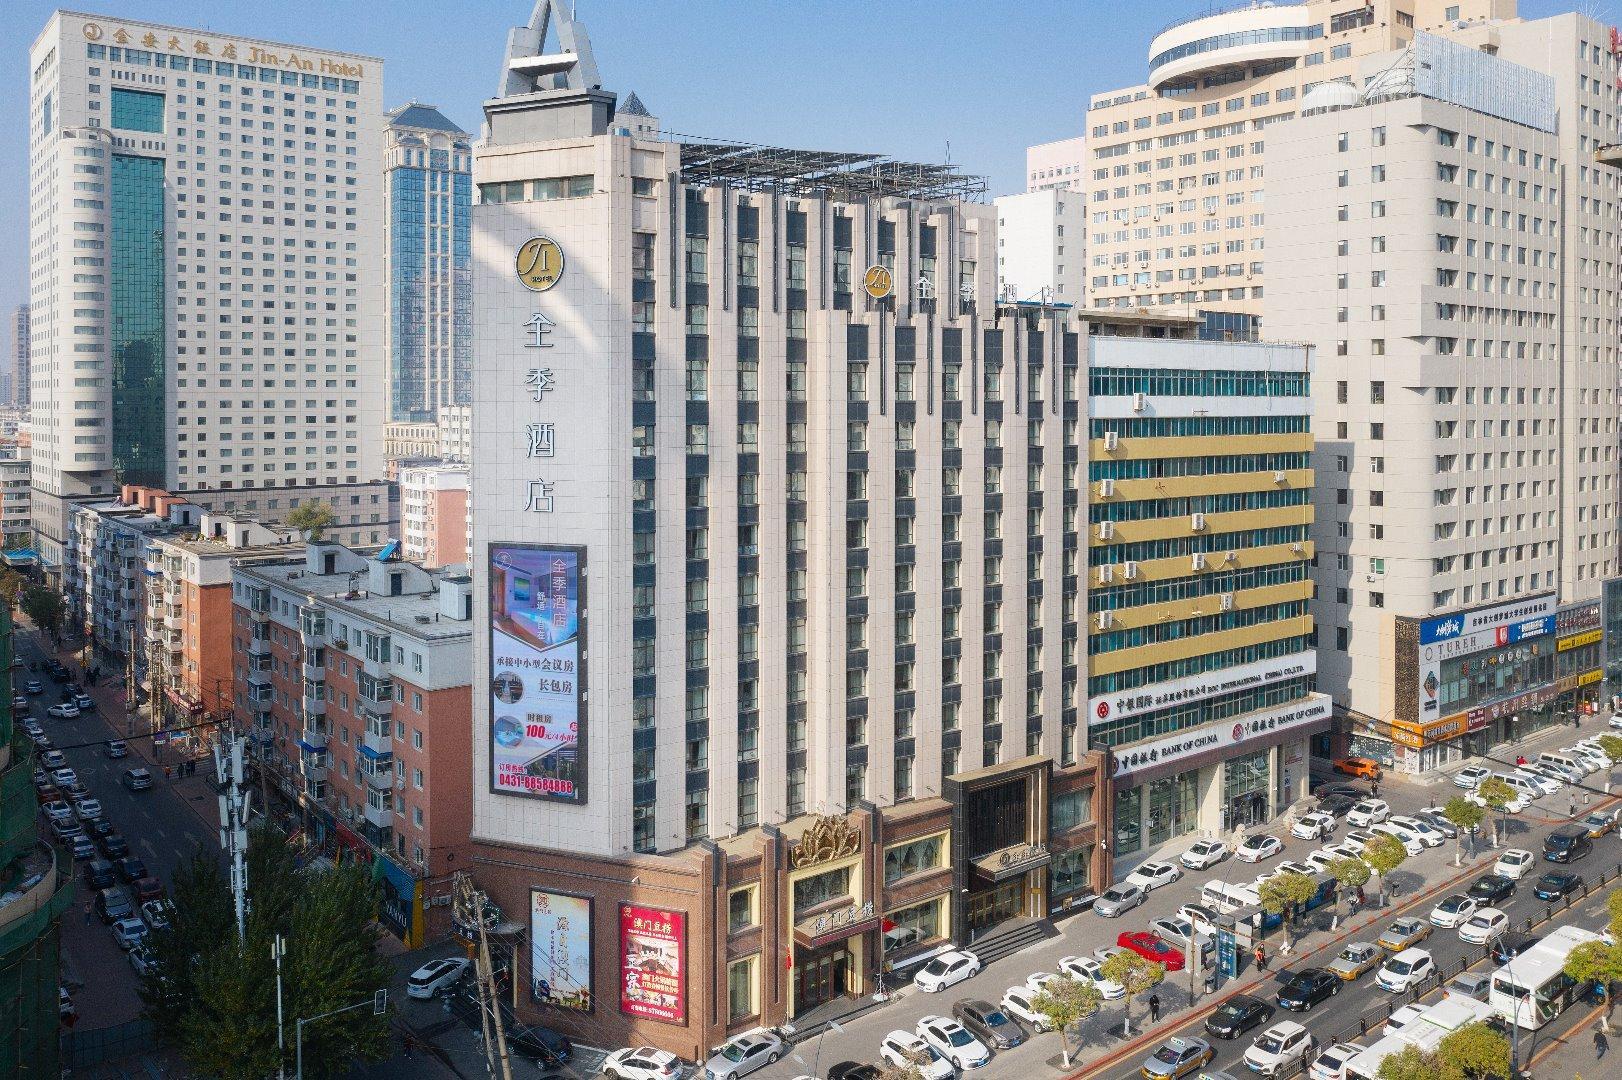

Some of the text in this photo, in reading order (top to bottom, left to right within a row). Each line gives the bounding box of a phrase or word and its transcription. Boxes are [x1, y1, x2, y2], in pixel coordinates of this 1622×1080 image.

[247, 46, 364, 78] Jin-An Hotel
[522, 312, 556, 513] 全季酒店
[552, 558, 567, 628] 全季酒店
[496, 656, 575, 672] 承接中小型会议房
[538, 678, 573, 693] 长包房
[1116, 695, 1153, 713] 中银国际
[1220, 675, 1262, 690] INTERNATIONAL
[1245, 705, 1325, 735] 中国银行 BANK OF CHINA
[1121, 734, 1218, 769] 中国银行 BANK OF CHINA
